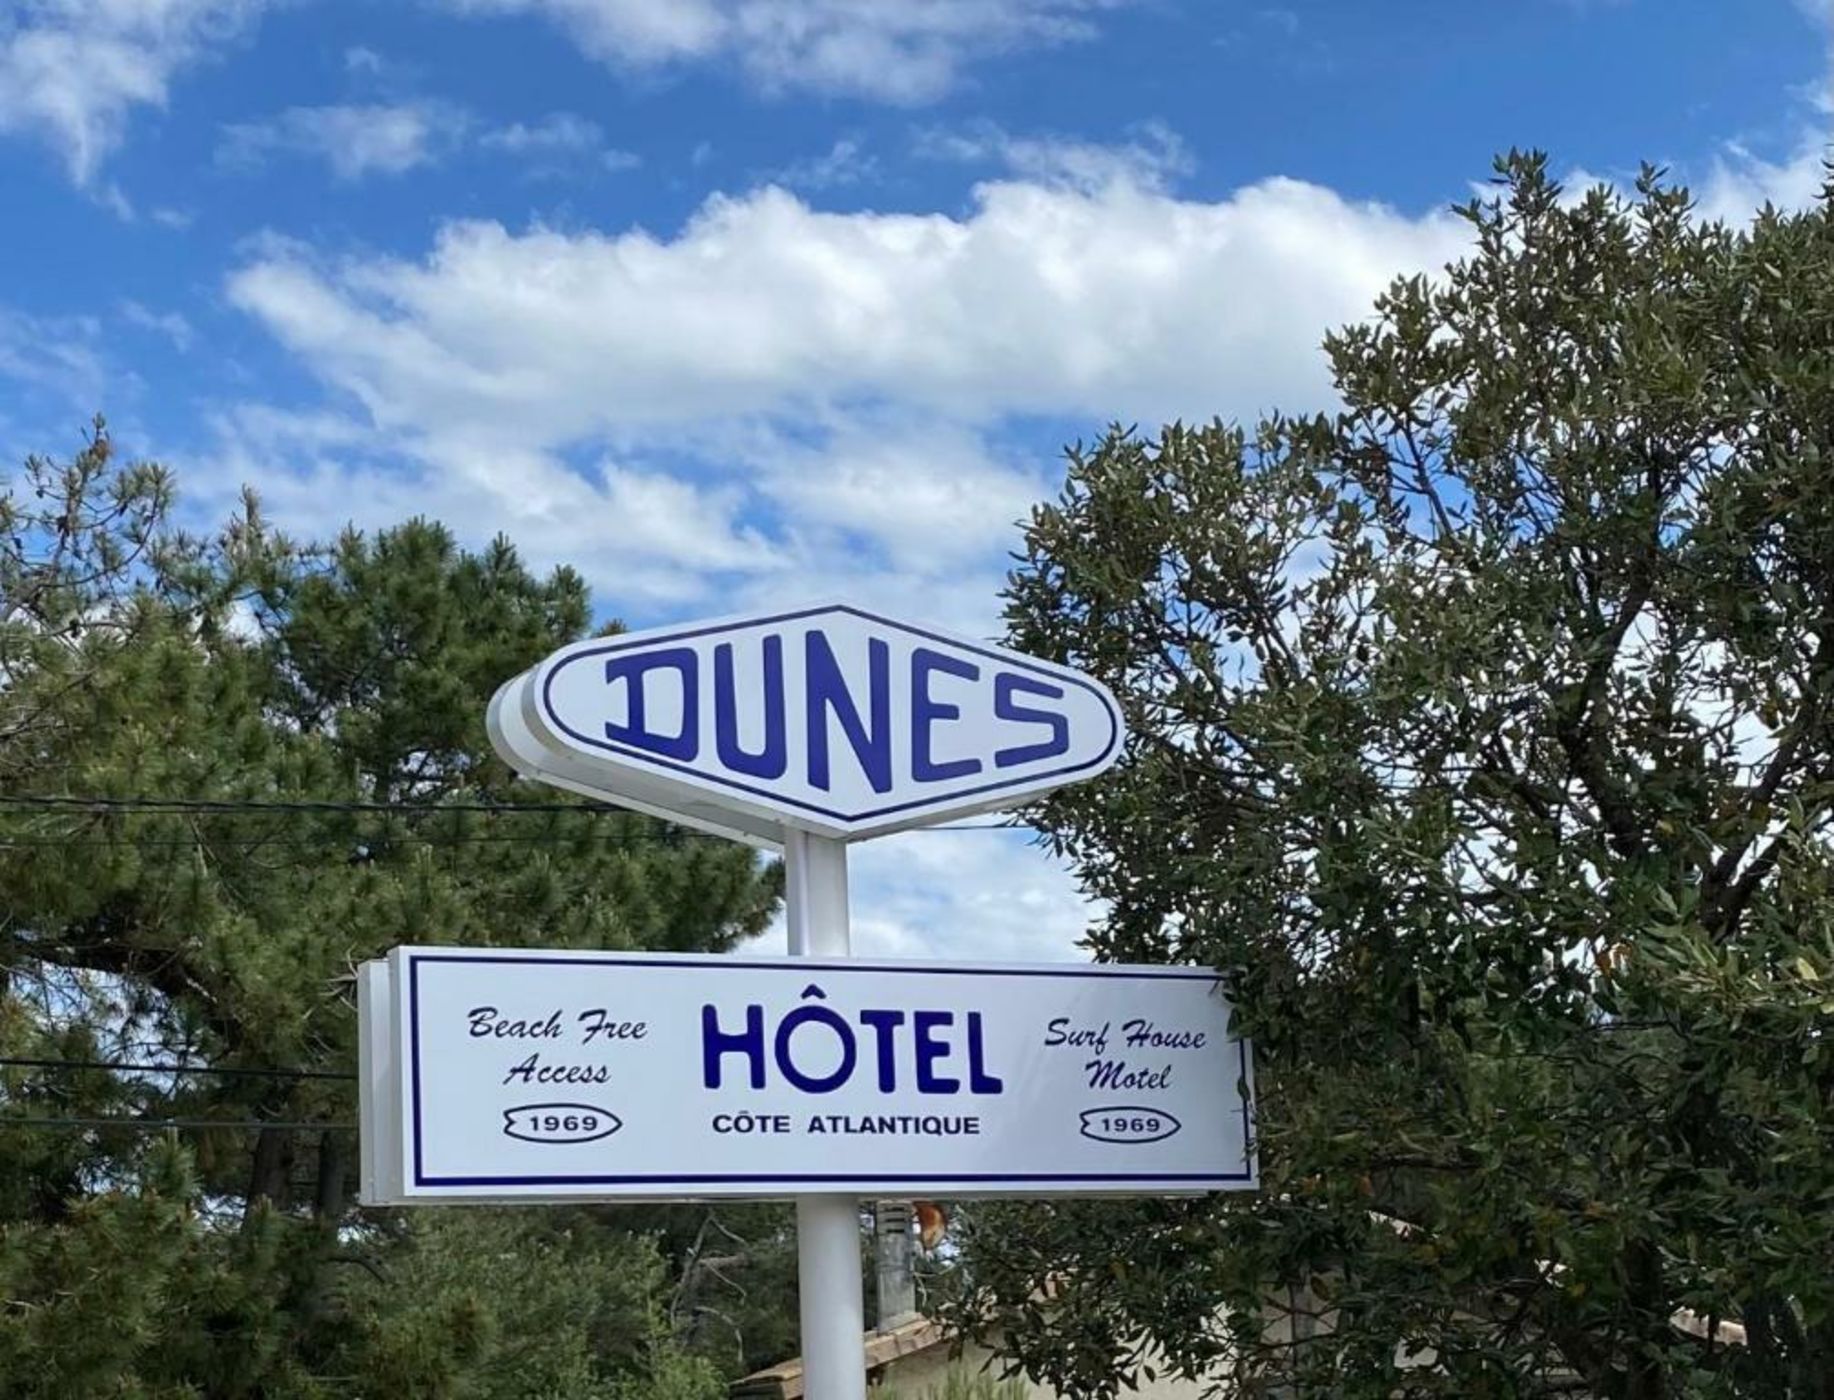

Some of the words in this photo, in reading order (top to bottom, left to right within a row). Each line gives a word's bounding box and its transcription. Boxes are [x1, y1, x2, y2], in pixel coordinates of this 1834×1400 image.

[605, 630, 1069, 794] DUNES
[467, 1007, 562, 1038] Beach
[578, 1009, 647, 1045] Free
[702, 984, 1003, 1094] HÔTEL
[1044, 1018, 1110, 1056] Surf
[1122, 1019, 1207, 1049] House
[503, 1052, 610, 1085] Access
[1085, 1060, 1172, 1090] Motel
[529, 1115, 600, 1132] 1969
[713, 1111, 790, 1133] CÔTE
[808, 1116, 980, 1136] ATLANTIQUE
[1101, 1117, 1162, 1133] 1969
